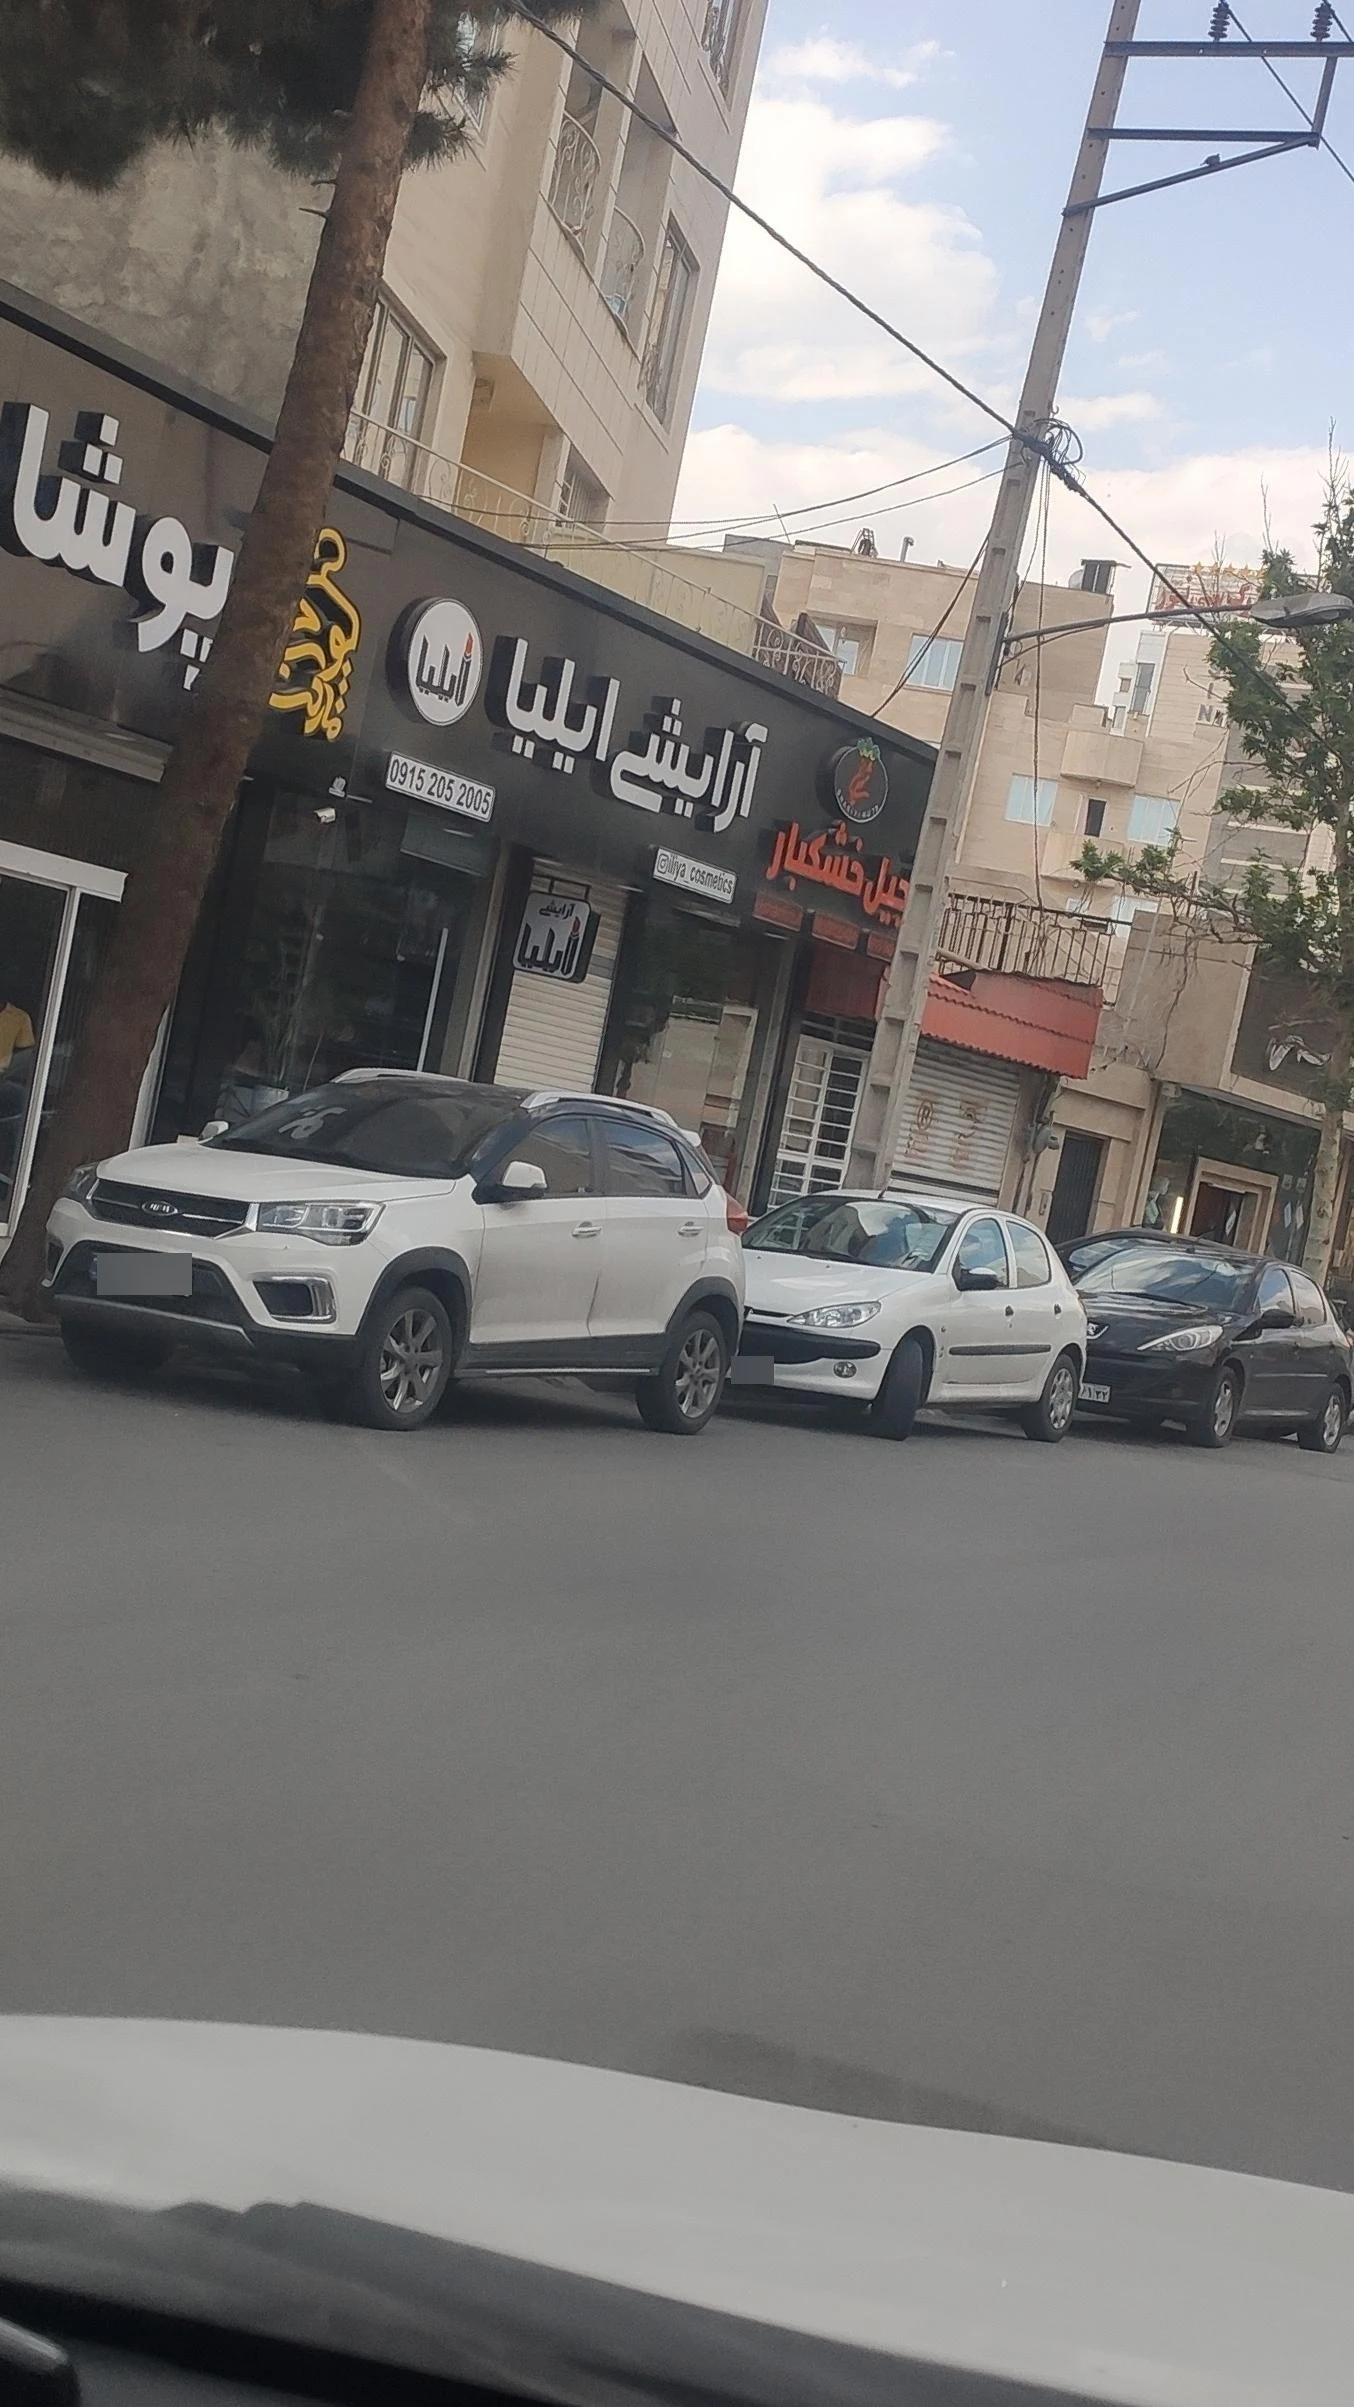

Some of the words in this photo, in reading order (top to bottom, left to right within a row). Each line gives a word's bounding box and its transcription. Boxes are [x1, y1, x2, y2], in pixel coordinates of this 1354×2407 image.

[506, 637, 621, 774] ایلیا
[389, 758, 426, 792] 0915
[427, 772, 455, 802] 205
[456, 783, 491, 815] 2005
[610, 698, 769, 832] آرایشی
[766, 819, 864, 896] خشکبار
[538, 899, 576, 919] آرایشی
